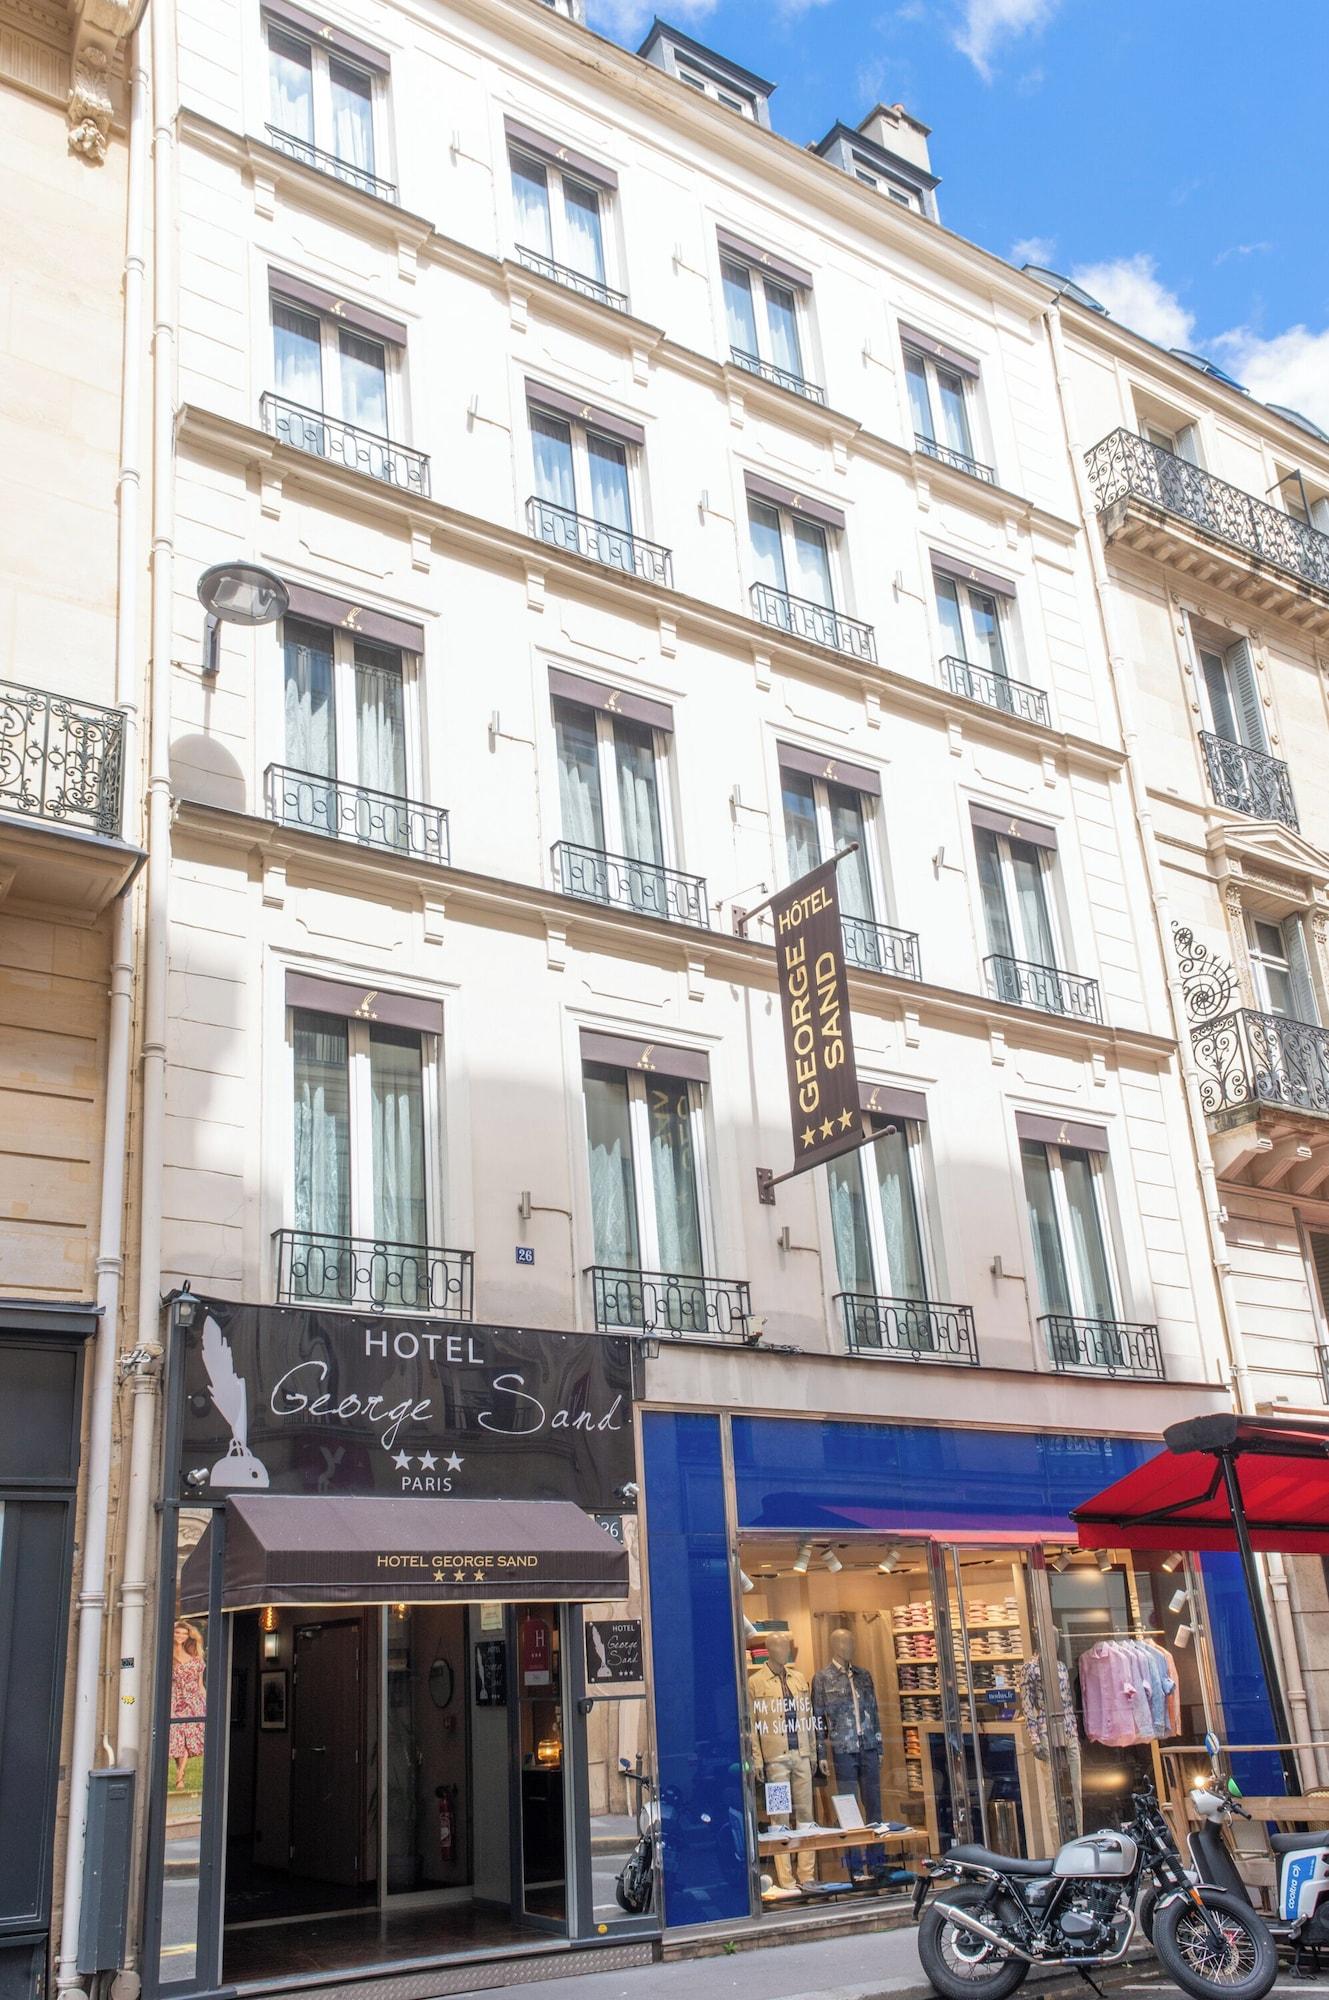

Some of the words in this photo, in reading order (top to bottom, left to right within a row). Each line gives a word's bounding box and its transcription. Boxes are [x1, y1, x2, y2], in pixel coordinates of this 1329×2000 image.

[779, 886, 833, 935] HÔTEL
[816, 952, 844, 1070] SAND
[785, 937, 820, 1112] GEORGE
[519, 1249, 532, 1262] 26
[364, 1329, 484, 1364] HOTEL
[270, 1360, 434, 1450] George
[477, 1373, 622, 1435] Sand
[401, 1475, 452, 1492] PARIS
[376, 1554, 428, 1568] HOTEL
[432, 1555, 494, 1568] GEORGE
[496, 1555, 538, 1568] SAND
[612, 1624, 635, 1632] HOTEL
[535, 1629, 545, 1647] H
[607, 1635, 639, 1654] George
[606, 1650, 639, 1666] Sand
[753, 1698, 768, 1715] MA
[754, 1719, 769, 1736] MA
